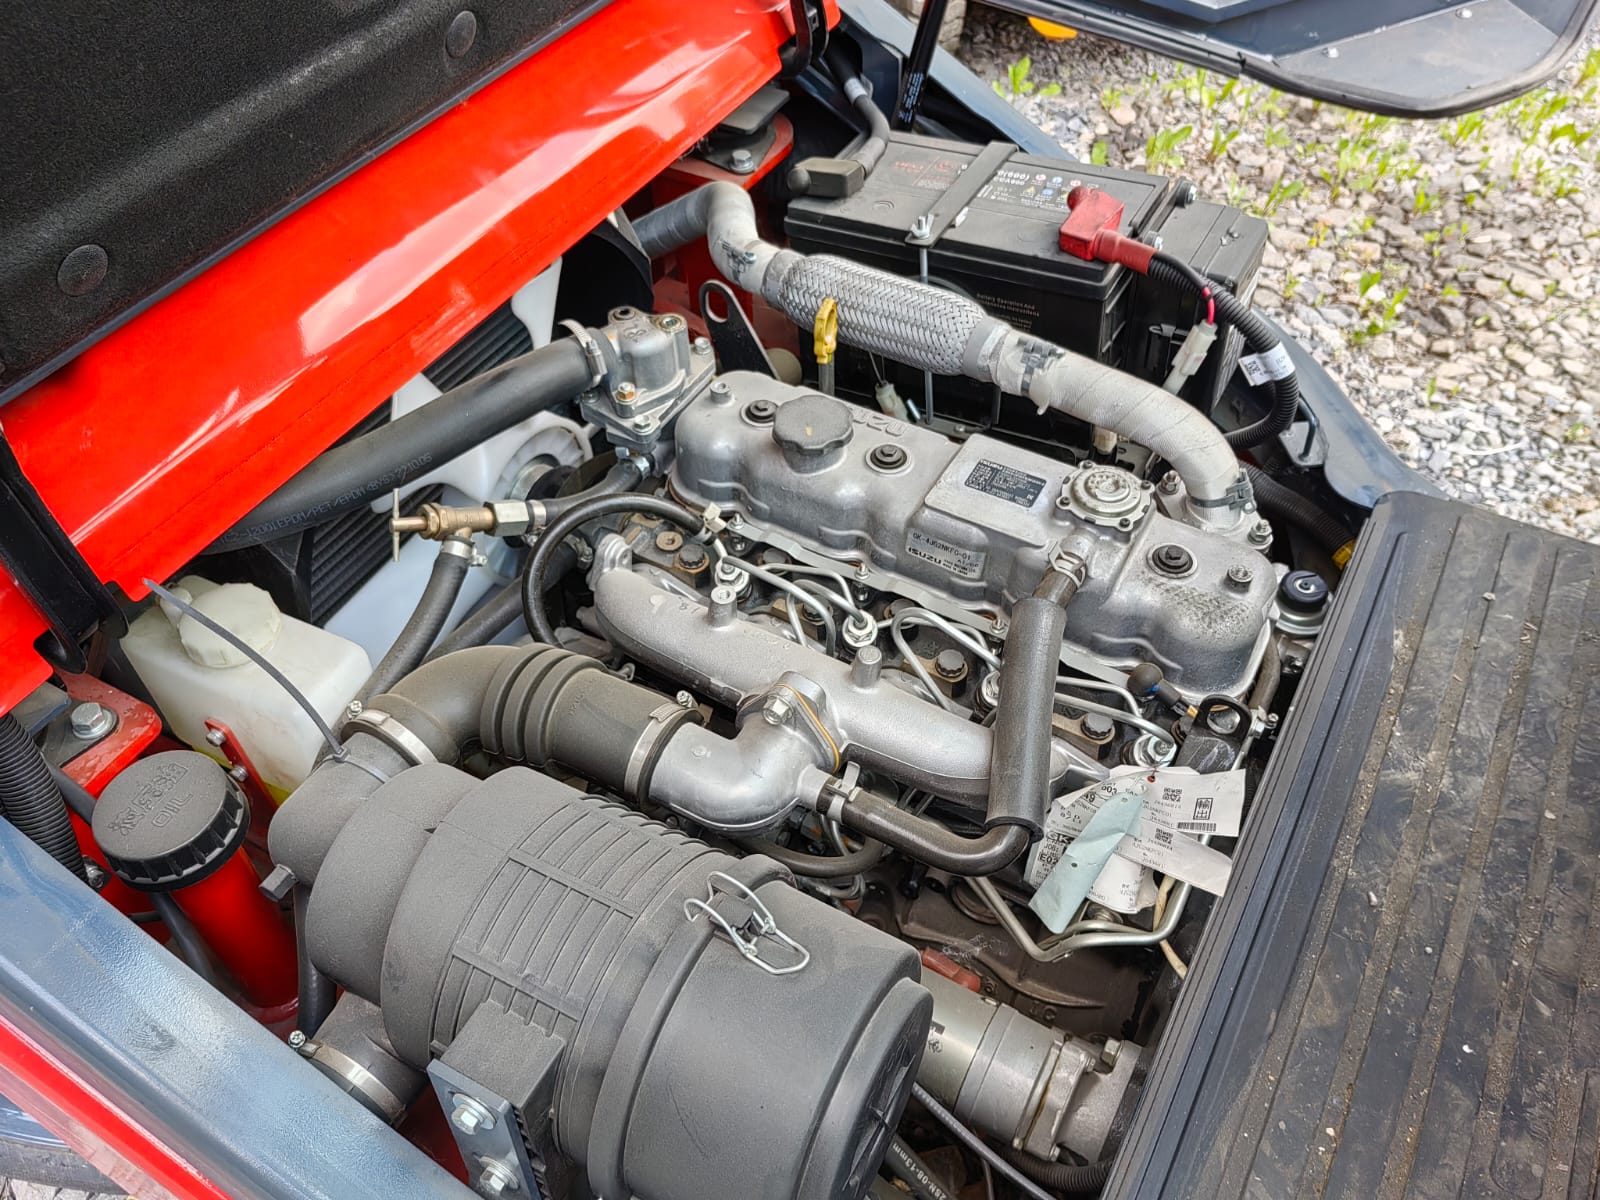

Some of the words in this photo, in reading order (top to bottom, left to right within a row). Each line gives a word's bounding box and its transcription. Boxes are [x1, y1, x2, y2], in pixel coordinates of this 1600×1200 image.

[853, 408, 904, 436] UZU
[908, 546, 942, 565] ISUZU
[151, 793, 194, 828] OIL
